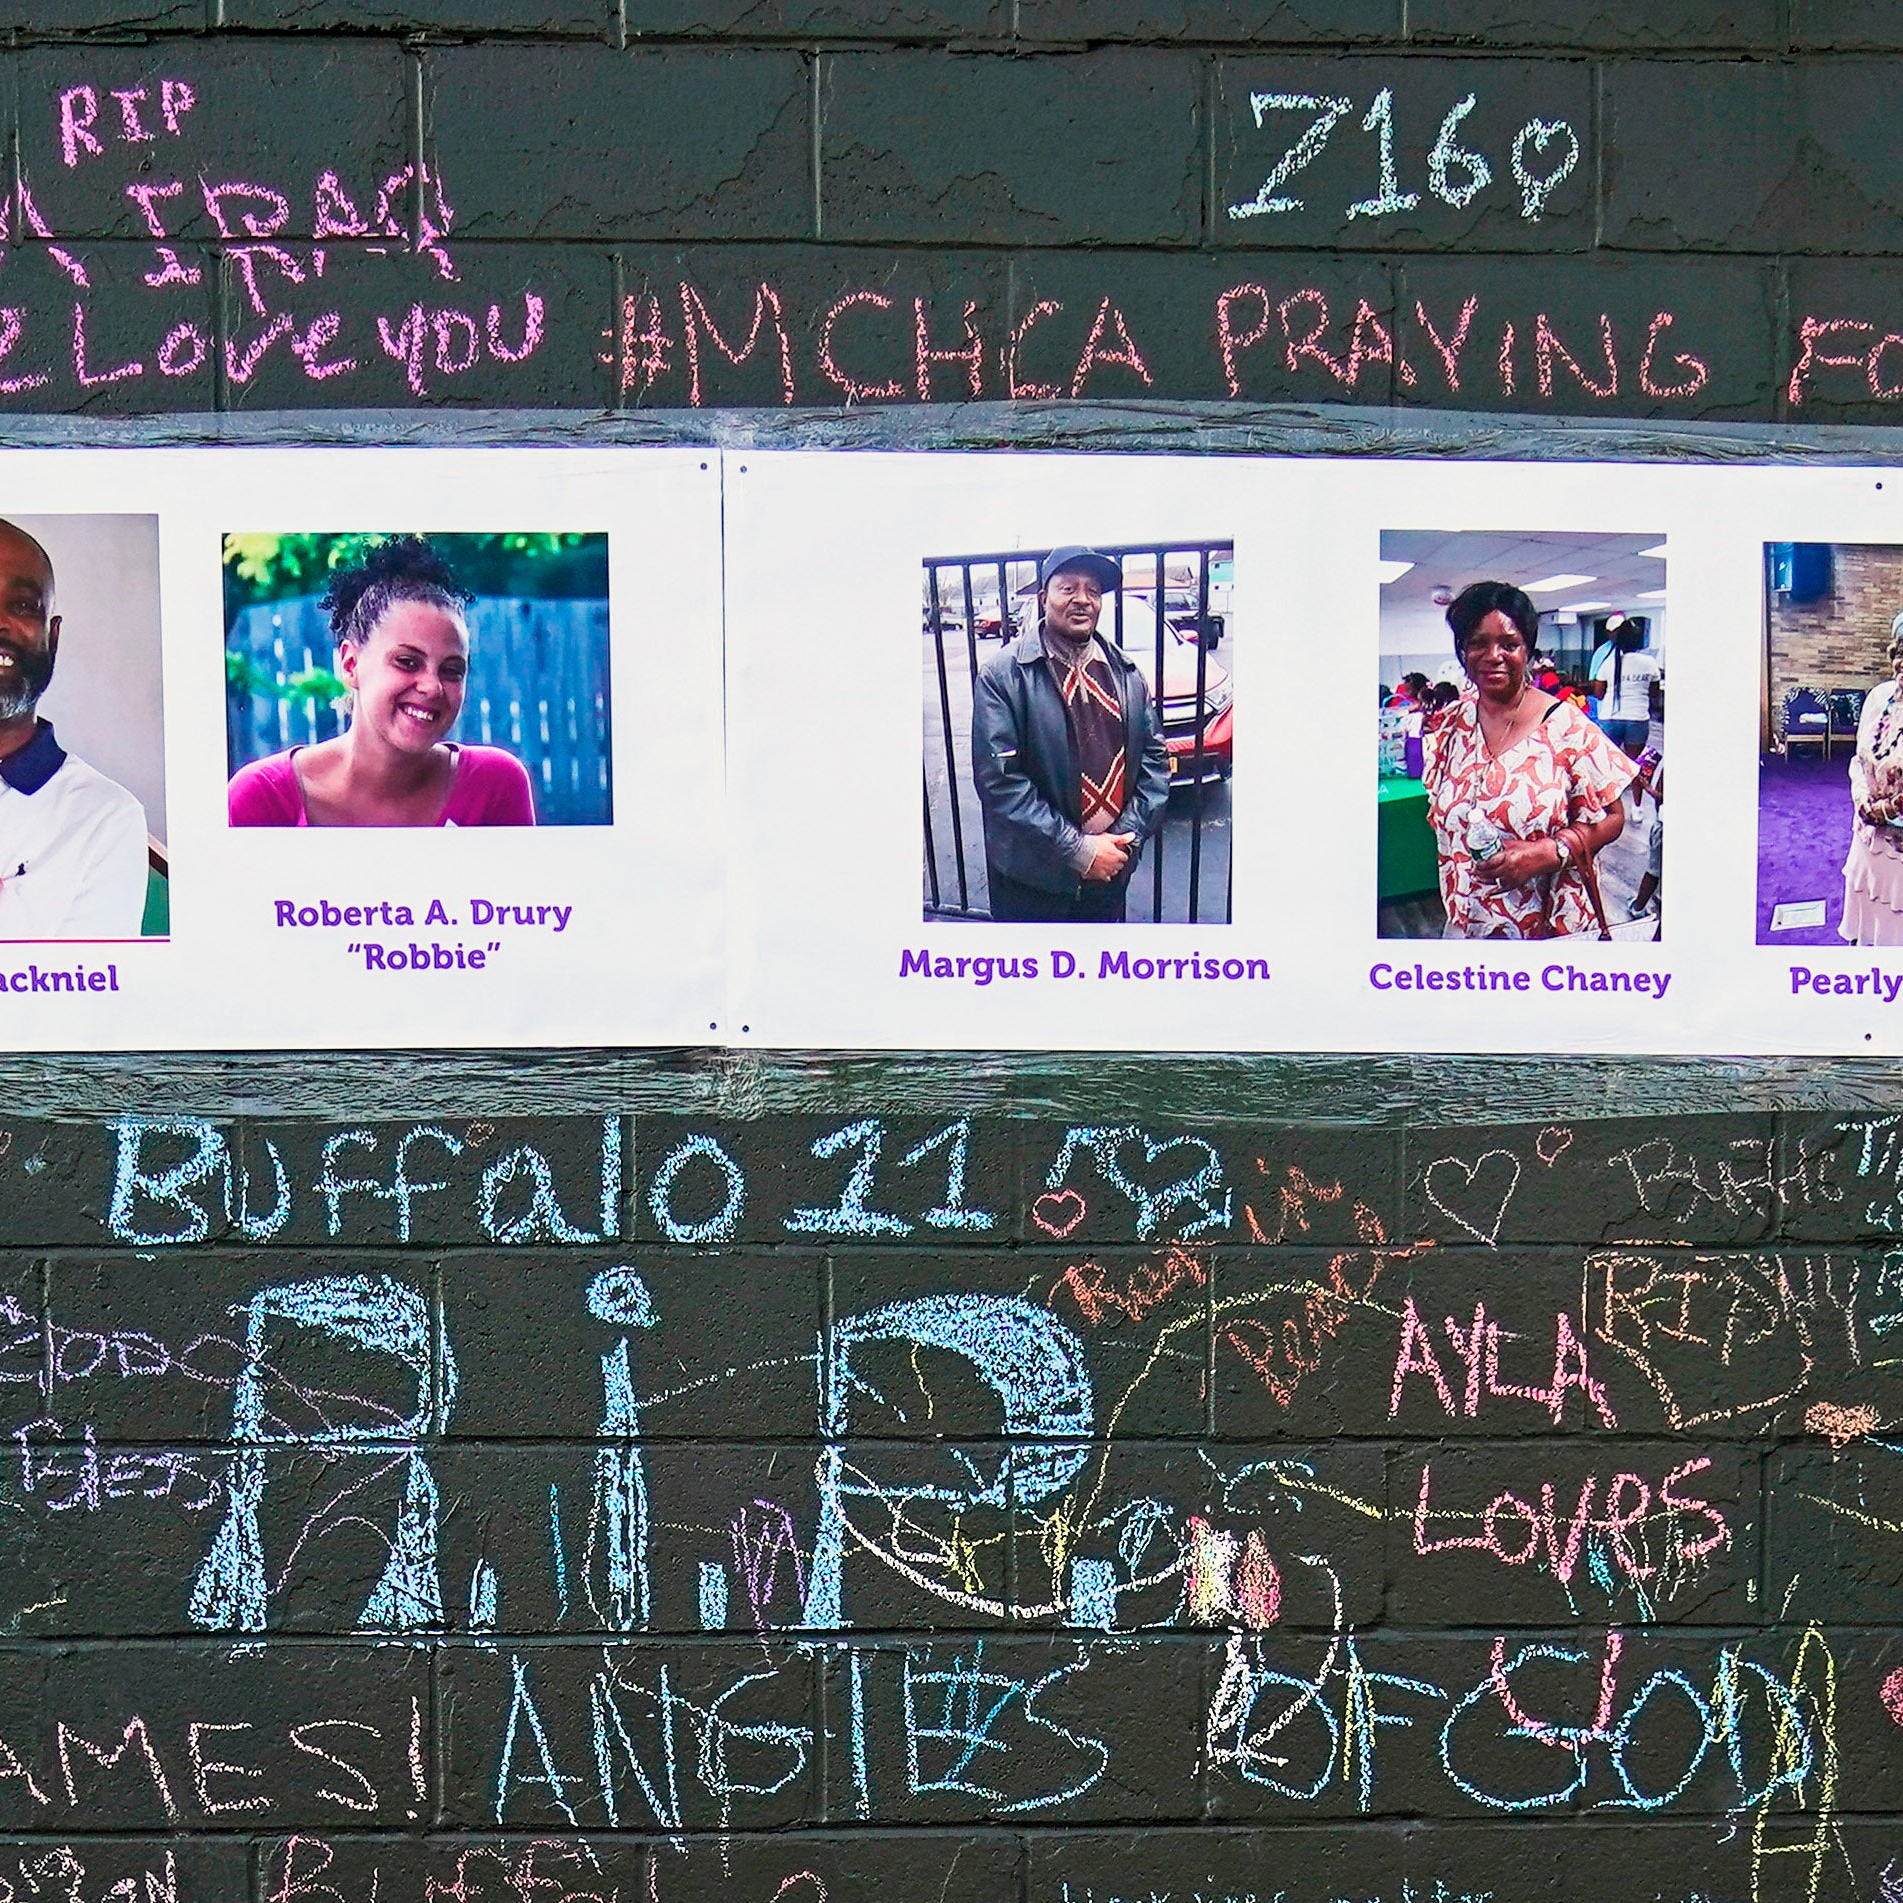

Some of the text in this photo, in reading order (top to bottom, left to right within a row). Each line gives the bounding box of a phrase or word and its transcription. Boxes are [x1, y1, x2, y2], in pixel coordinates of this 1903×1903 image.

[59, 78, 197, 167] RIP
[1216, 282, 1707, 400] PRAYING
[275, 900, 574, 934] Roberta A. Drury
[899, 950, 1272, 988] Margus D. Morrison
[1370, 964, 1673, 1001] Celestine Chaney
